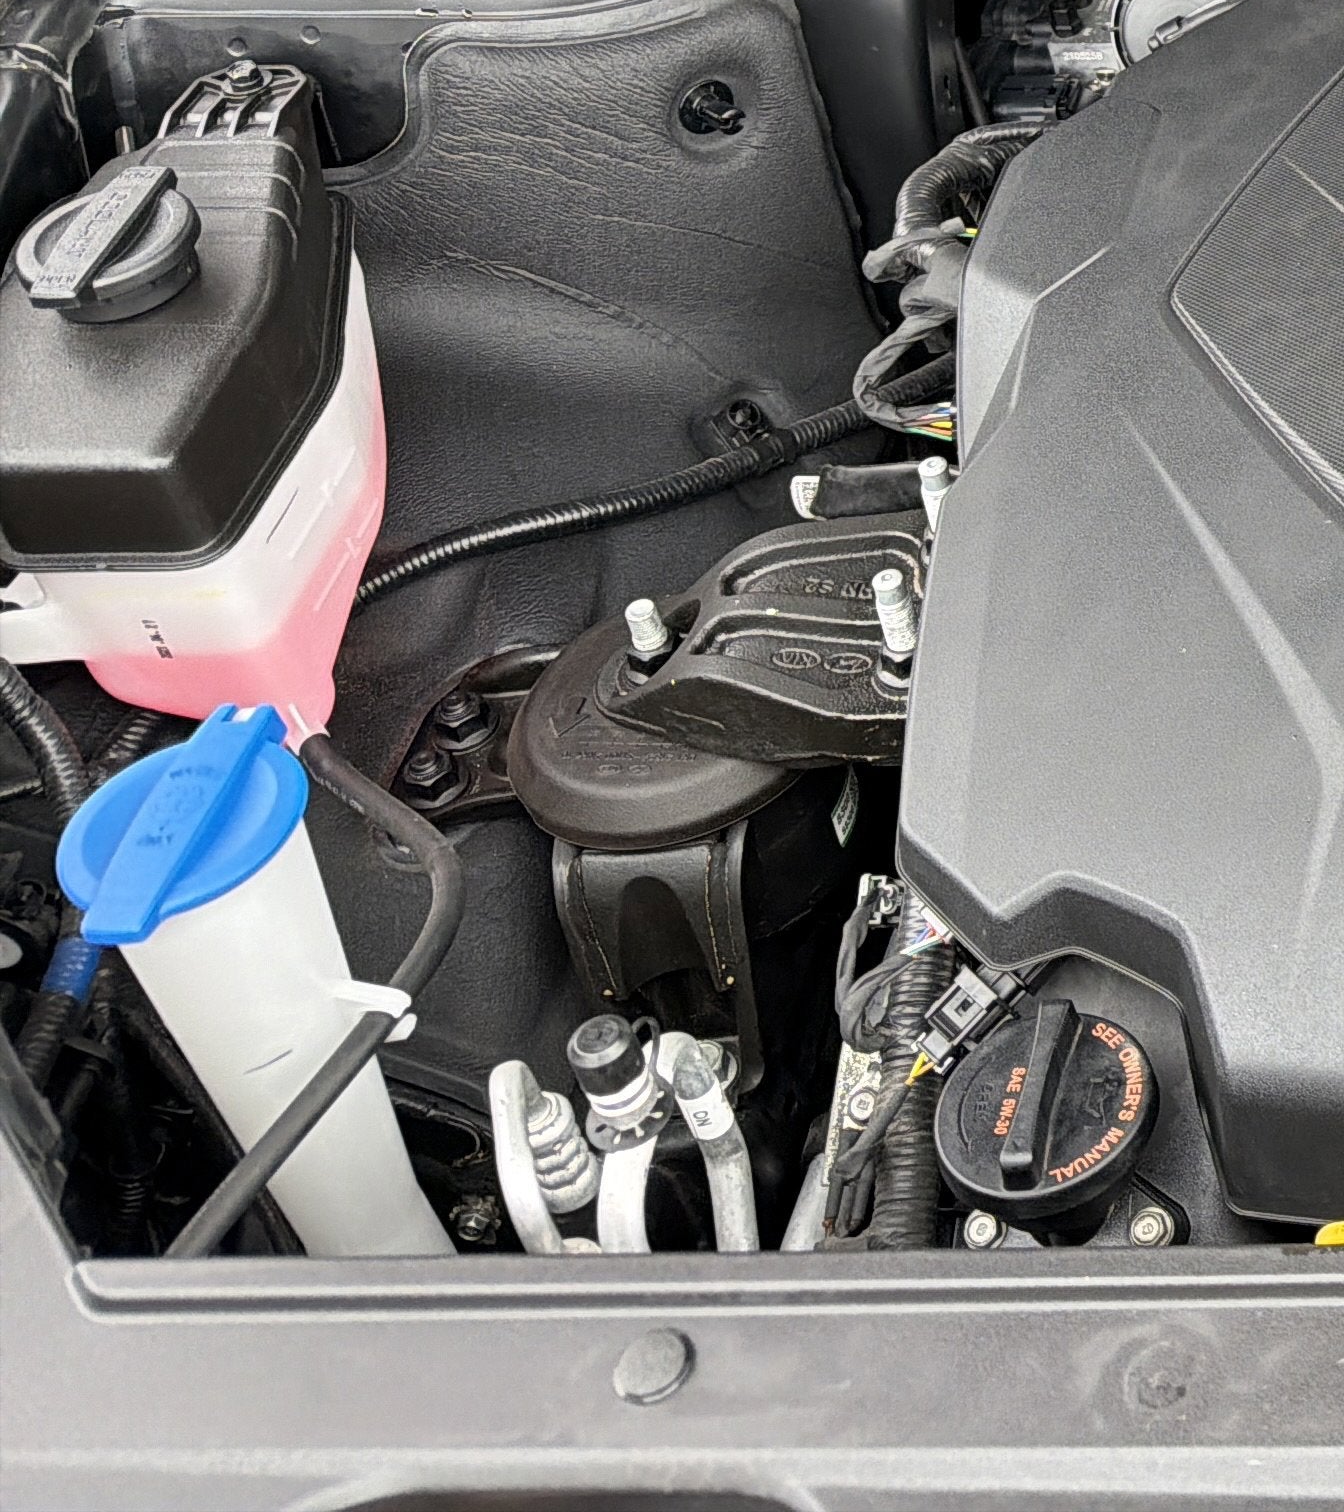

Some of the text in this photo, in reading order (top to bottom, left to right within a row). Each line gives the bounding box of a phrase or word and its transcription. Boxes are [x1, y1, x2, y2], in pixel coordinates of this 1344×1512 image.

[993, 1066, 1027, 1136] SAE 5W-30
[1048, 1022, 1144, 1183] SEE OWNER'S MANUAL
